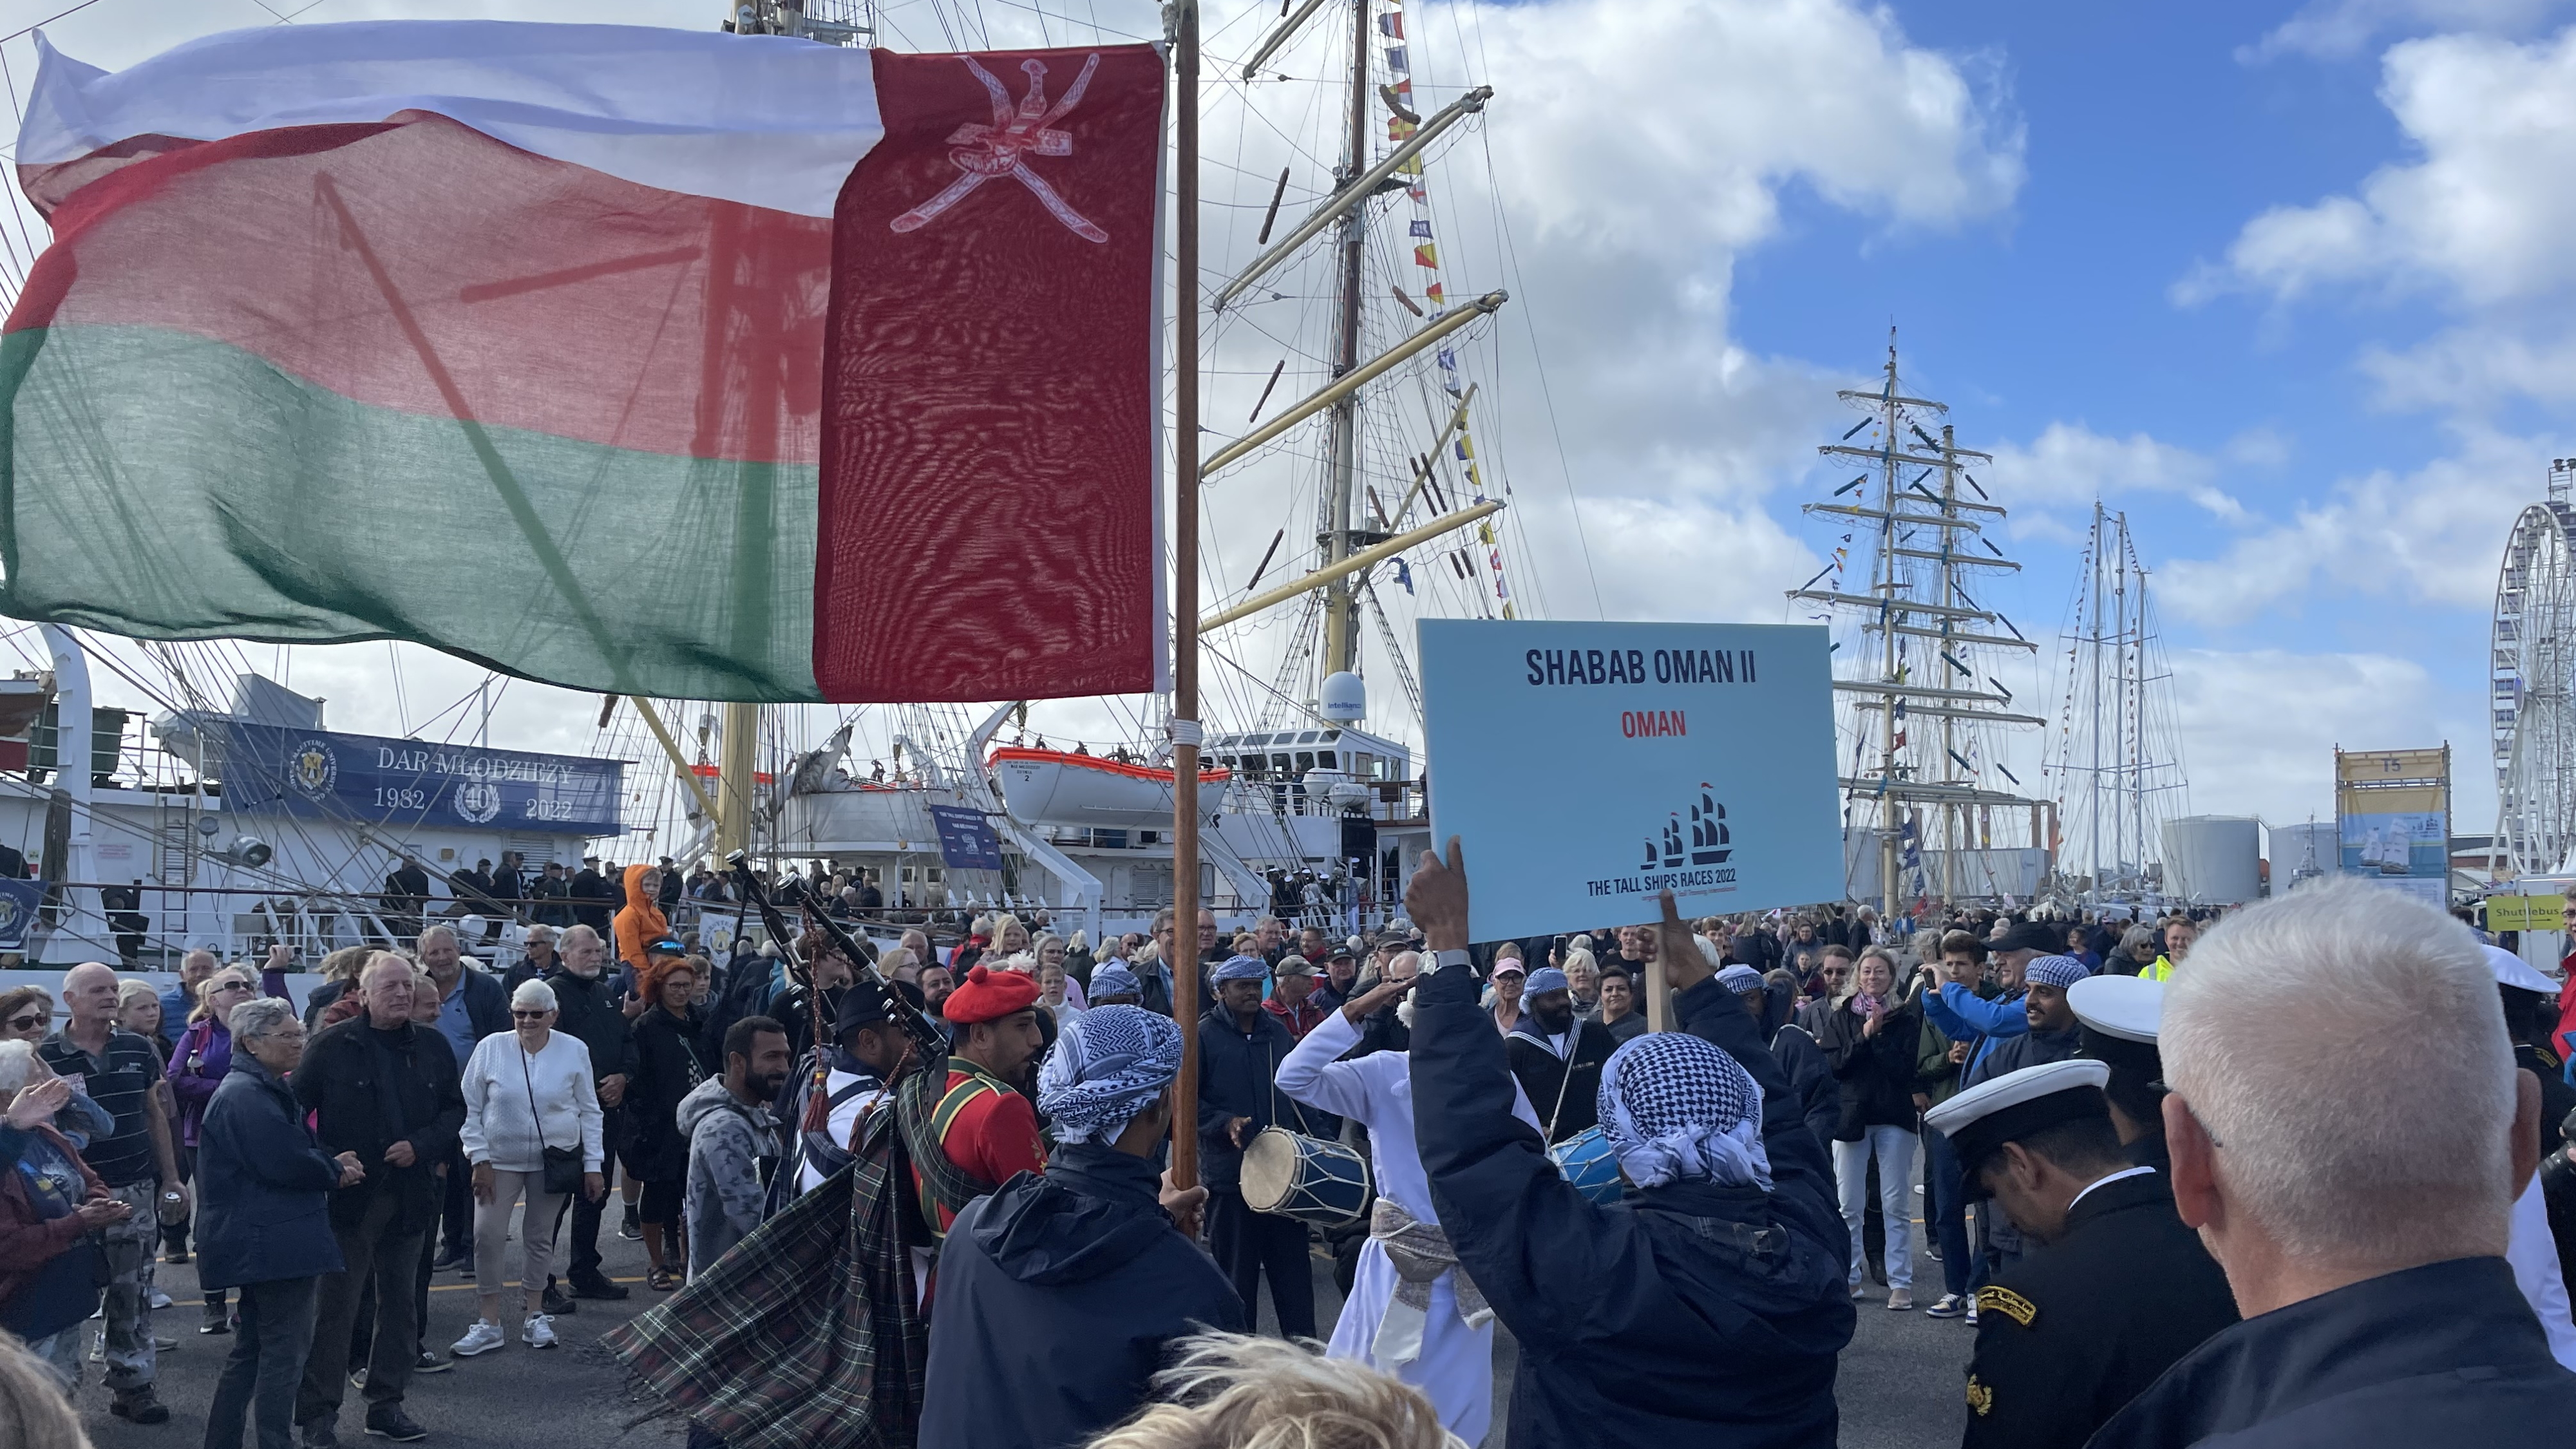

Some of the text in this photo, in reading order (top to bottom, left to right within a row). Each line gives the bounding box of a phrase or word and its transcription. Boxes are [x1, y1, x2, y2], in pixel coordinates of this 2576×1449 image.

[1526, 649, 1756, 685] SHABAB OMAN II
[1622, 710, 1686, 738] OMAN
[377, 746, 574, 784] DAR MŁODZIEŻY
[2382, 758, 2401, 772] T5
[374, 787, 424, 810] 1982
[465, 788, 489, 809] 40
[526, 798, 572, 819] 2022
[1587, 867, 1736, 896] THE TALL SHIPS RACES 2022
[2496, 907, 2559, 917] Shutlebus
